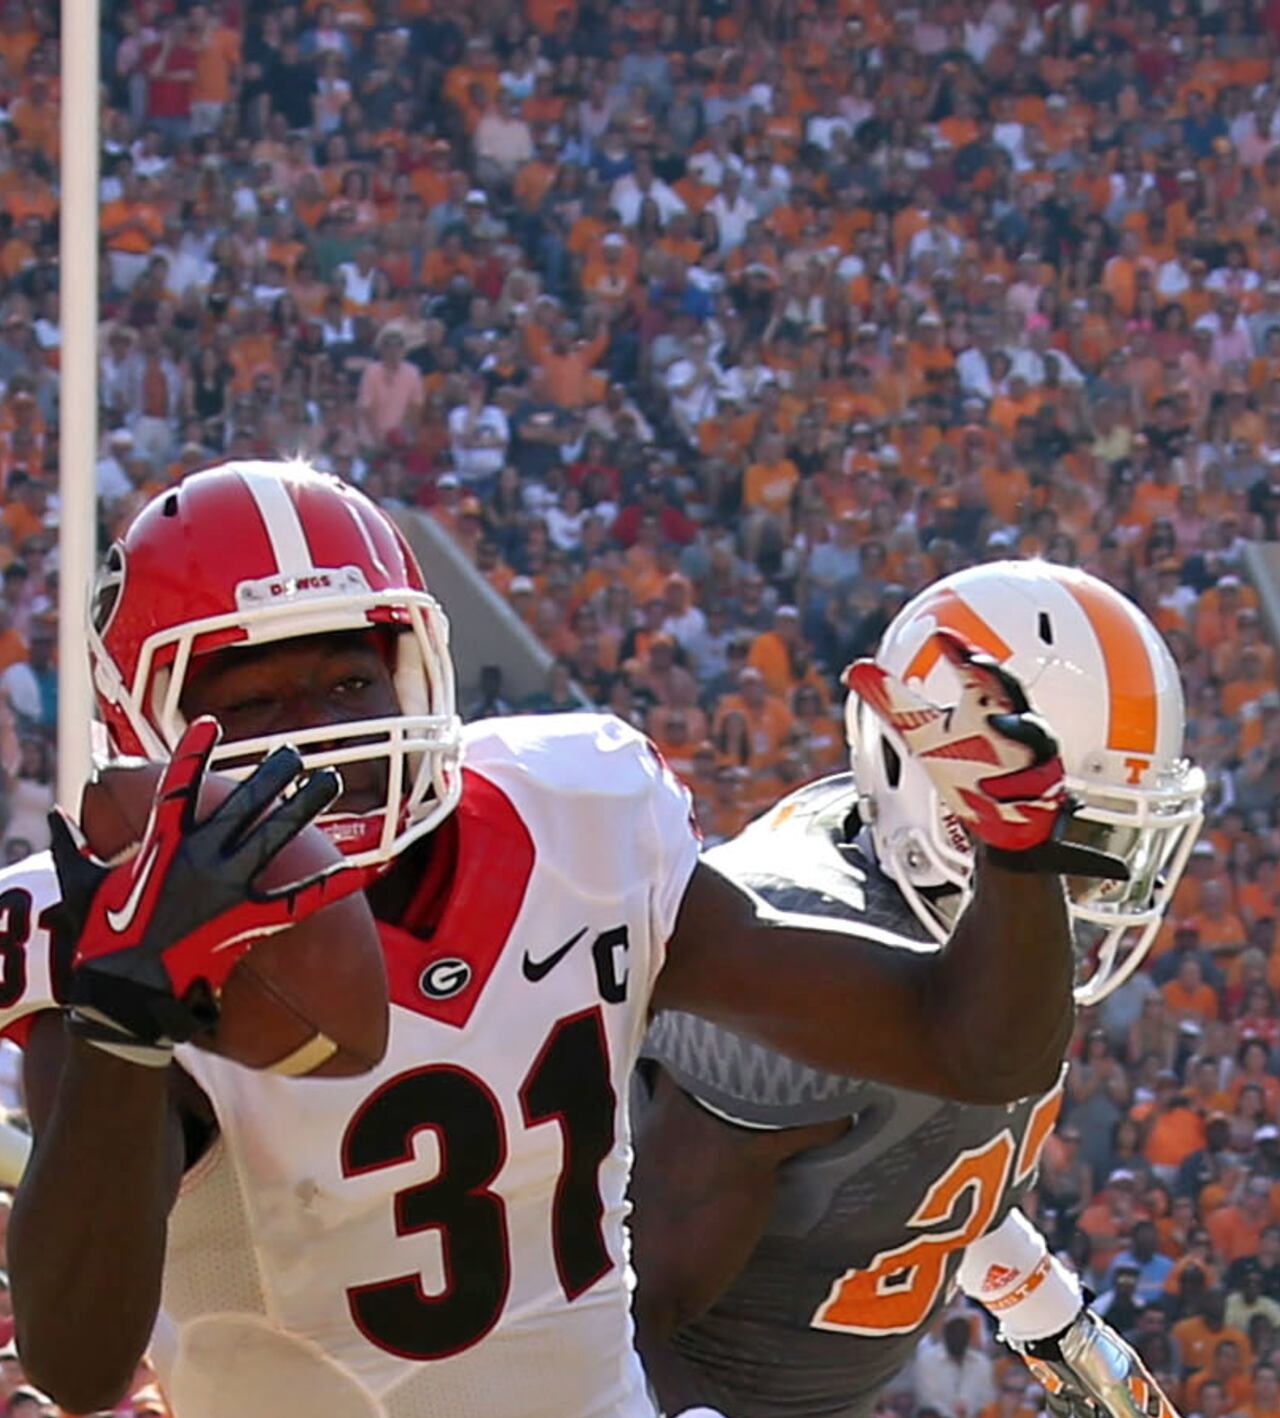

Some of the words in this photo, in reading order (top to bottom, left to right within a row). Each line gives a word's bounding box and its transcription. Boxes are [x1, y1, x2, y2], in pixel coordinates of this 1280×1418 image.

[271, 575, 331, 596] DWGS
[1124, 757, 1151, 785] T
[423, 960, 469, 997] G
[592, 926, 629, 1004] C
[340, 1003, 617, 1361] 31
